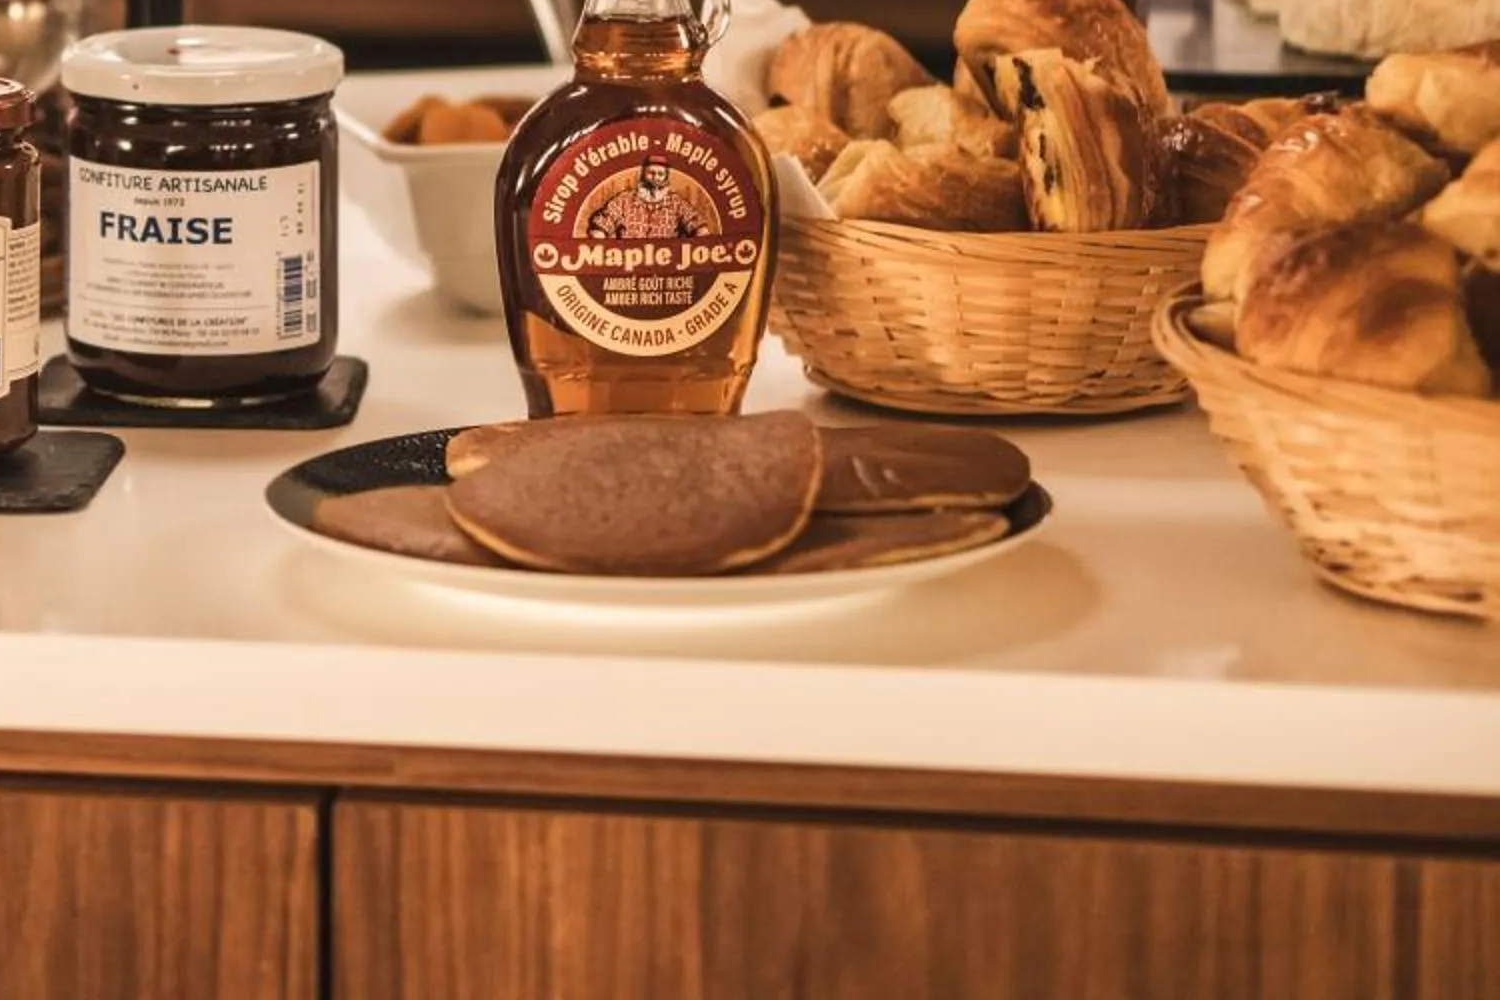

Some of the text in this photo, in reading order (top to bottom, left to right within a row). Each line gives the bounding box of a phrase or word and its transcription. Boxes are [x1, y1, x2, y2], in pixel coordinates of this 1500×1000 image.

[79, 167, 268, 193] CONFITURE ARTISANALE
[543, 173, 580, 224] Sirop
[574, 132, 649, 178] d'érable
[665, 132, 719, 172] Maple
[715, 169, 748, 220] syrup
[99, 210, 233, 245] FRAISE
[561, 243, 672, 272] Maple
[665, 290, 693, 305] TASTE
[556, 283, 611, 338] ORIGINE
[610, 324, 676, 347] CANADA
[685, 294, 730, 336] GRADE
[725, 281, 738, 295] A
